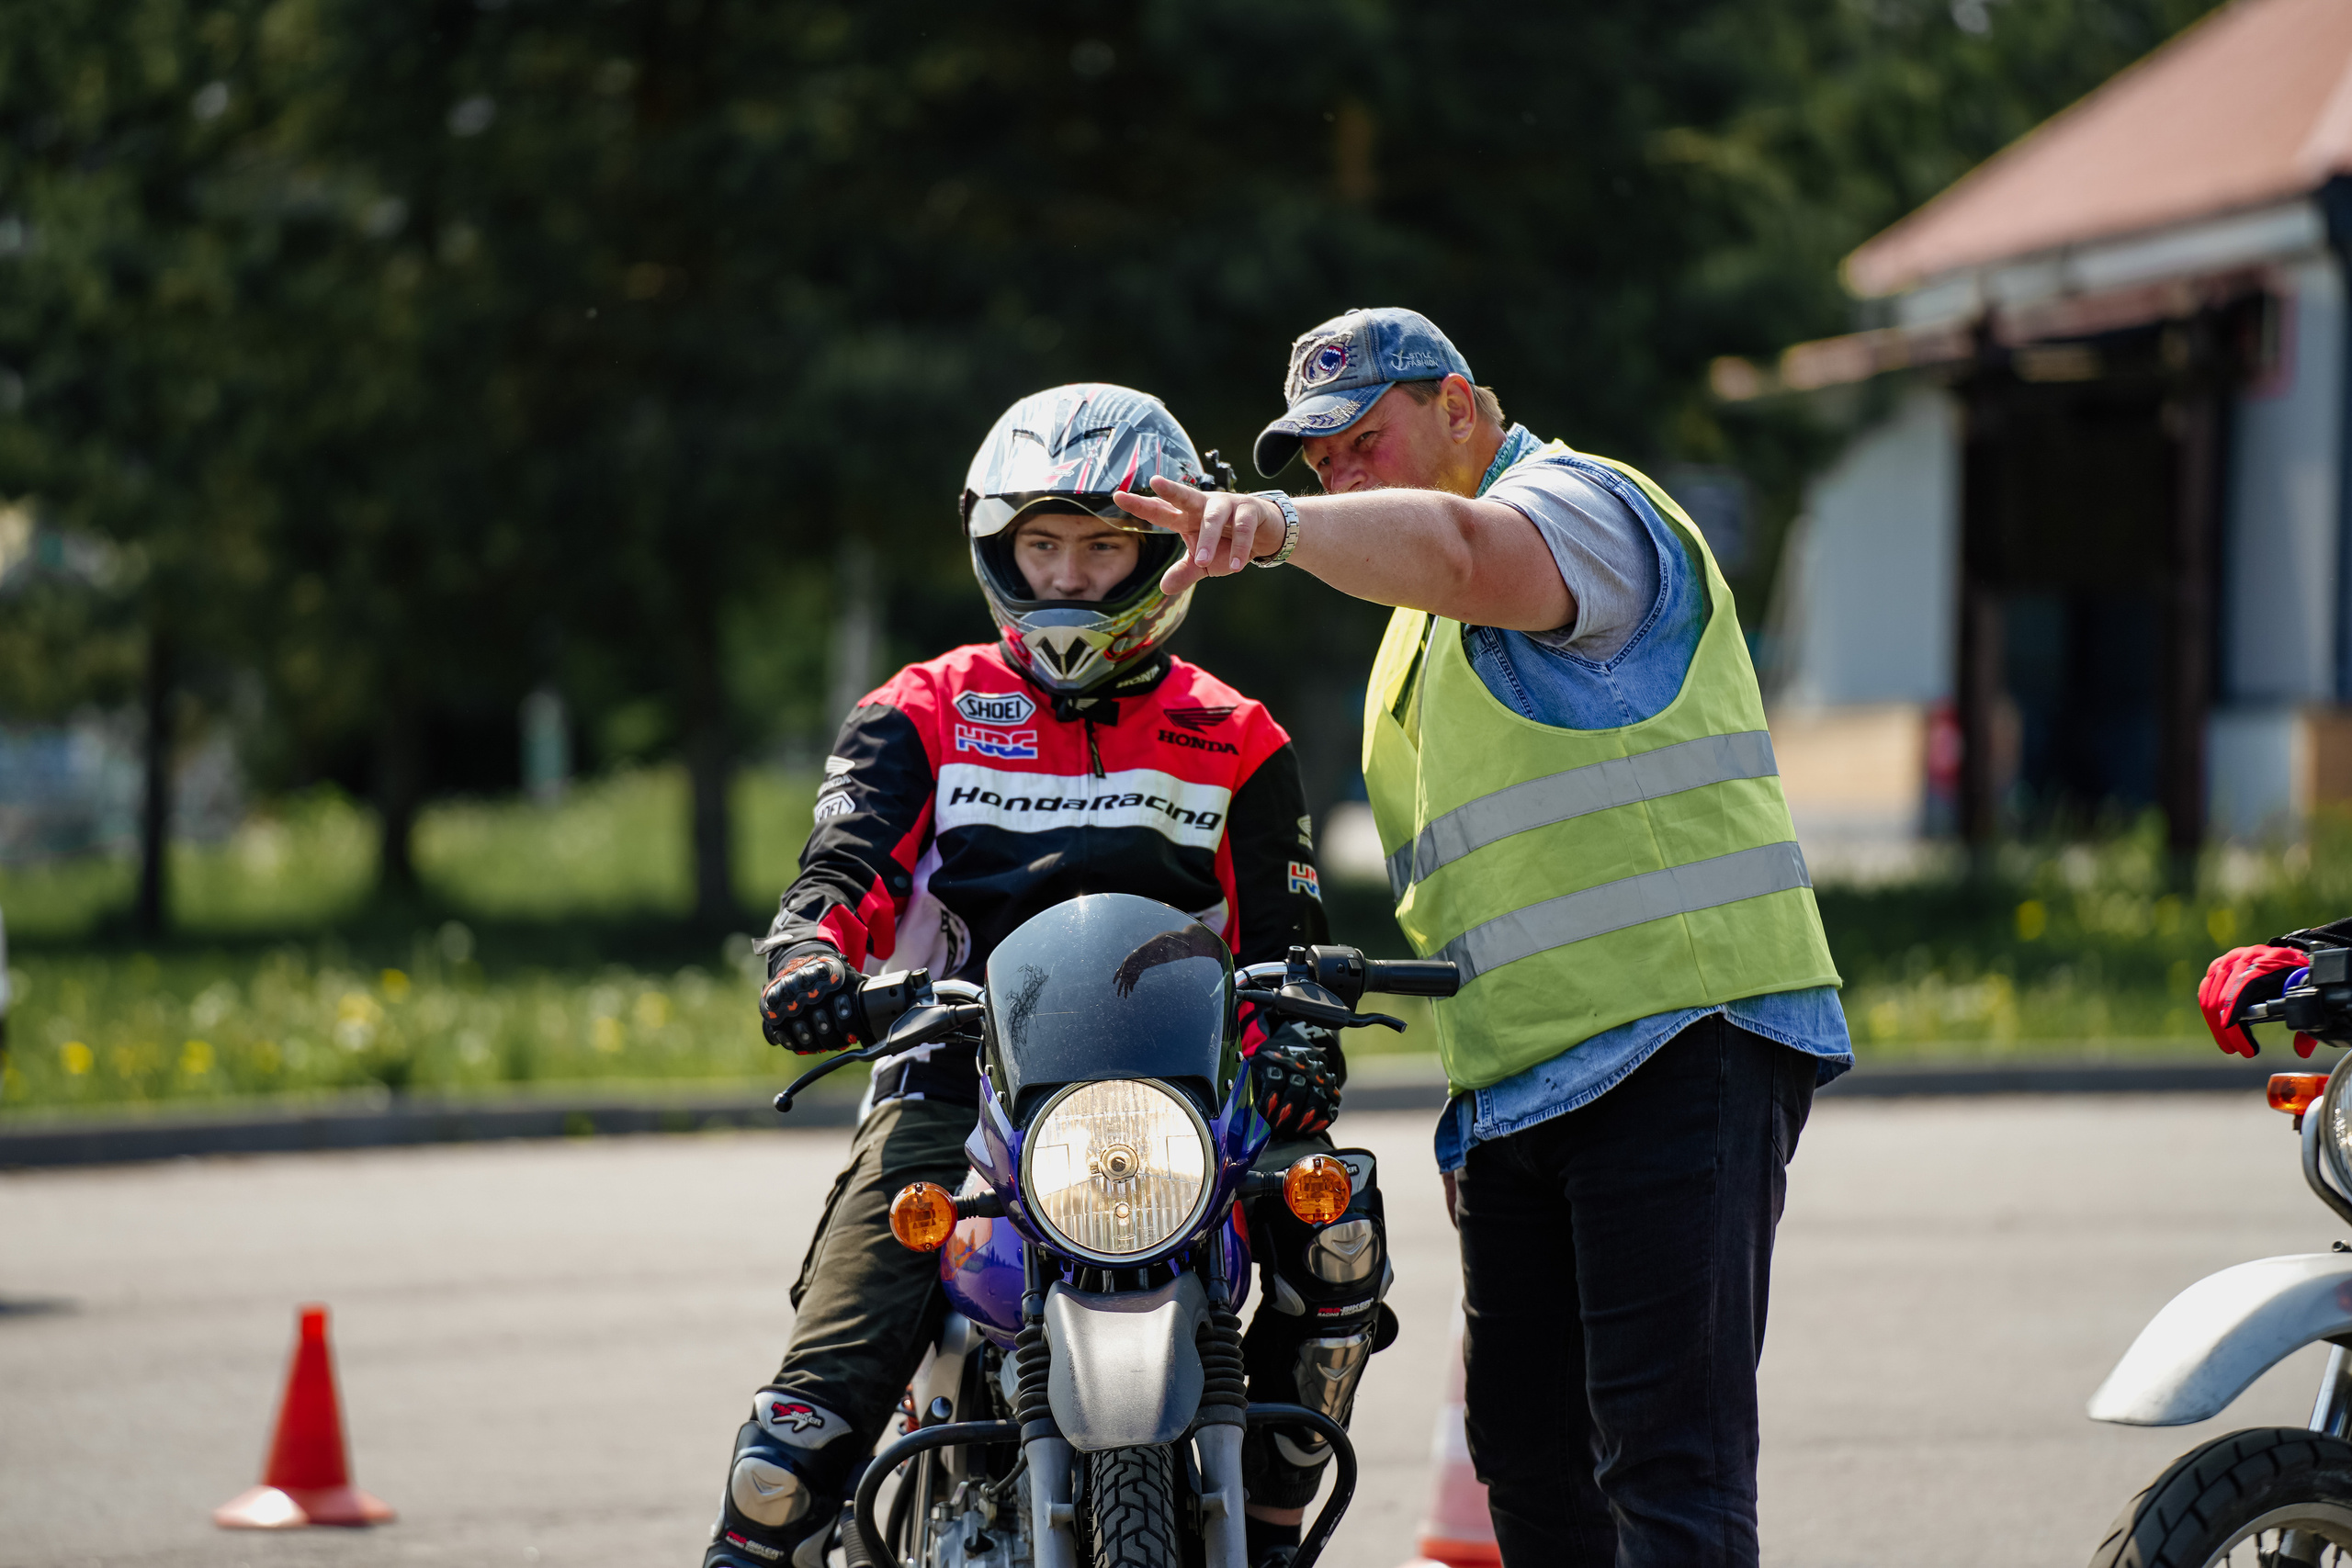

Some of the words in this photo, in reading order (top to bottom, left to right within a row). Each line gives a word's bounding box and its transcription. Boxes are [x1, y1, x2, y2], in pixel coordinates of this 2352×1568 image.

[1407, 358, 1440, 367] FASHION
[967, 698, 1022, 719] SHOEI
[955, 723, 1038, 760] HRC
[1157, 728, 1239, 756] HONDA
